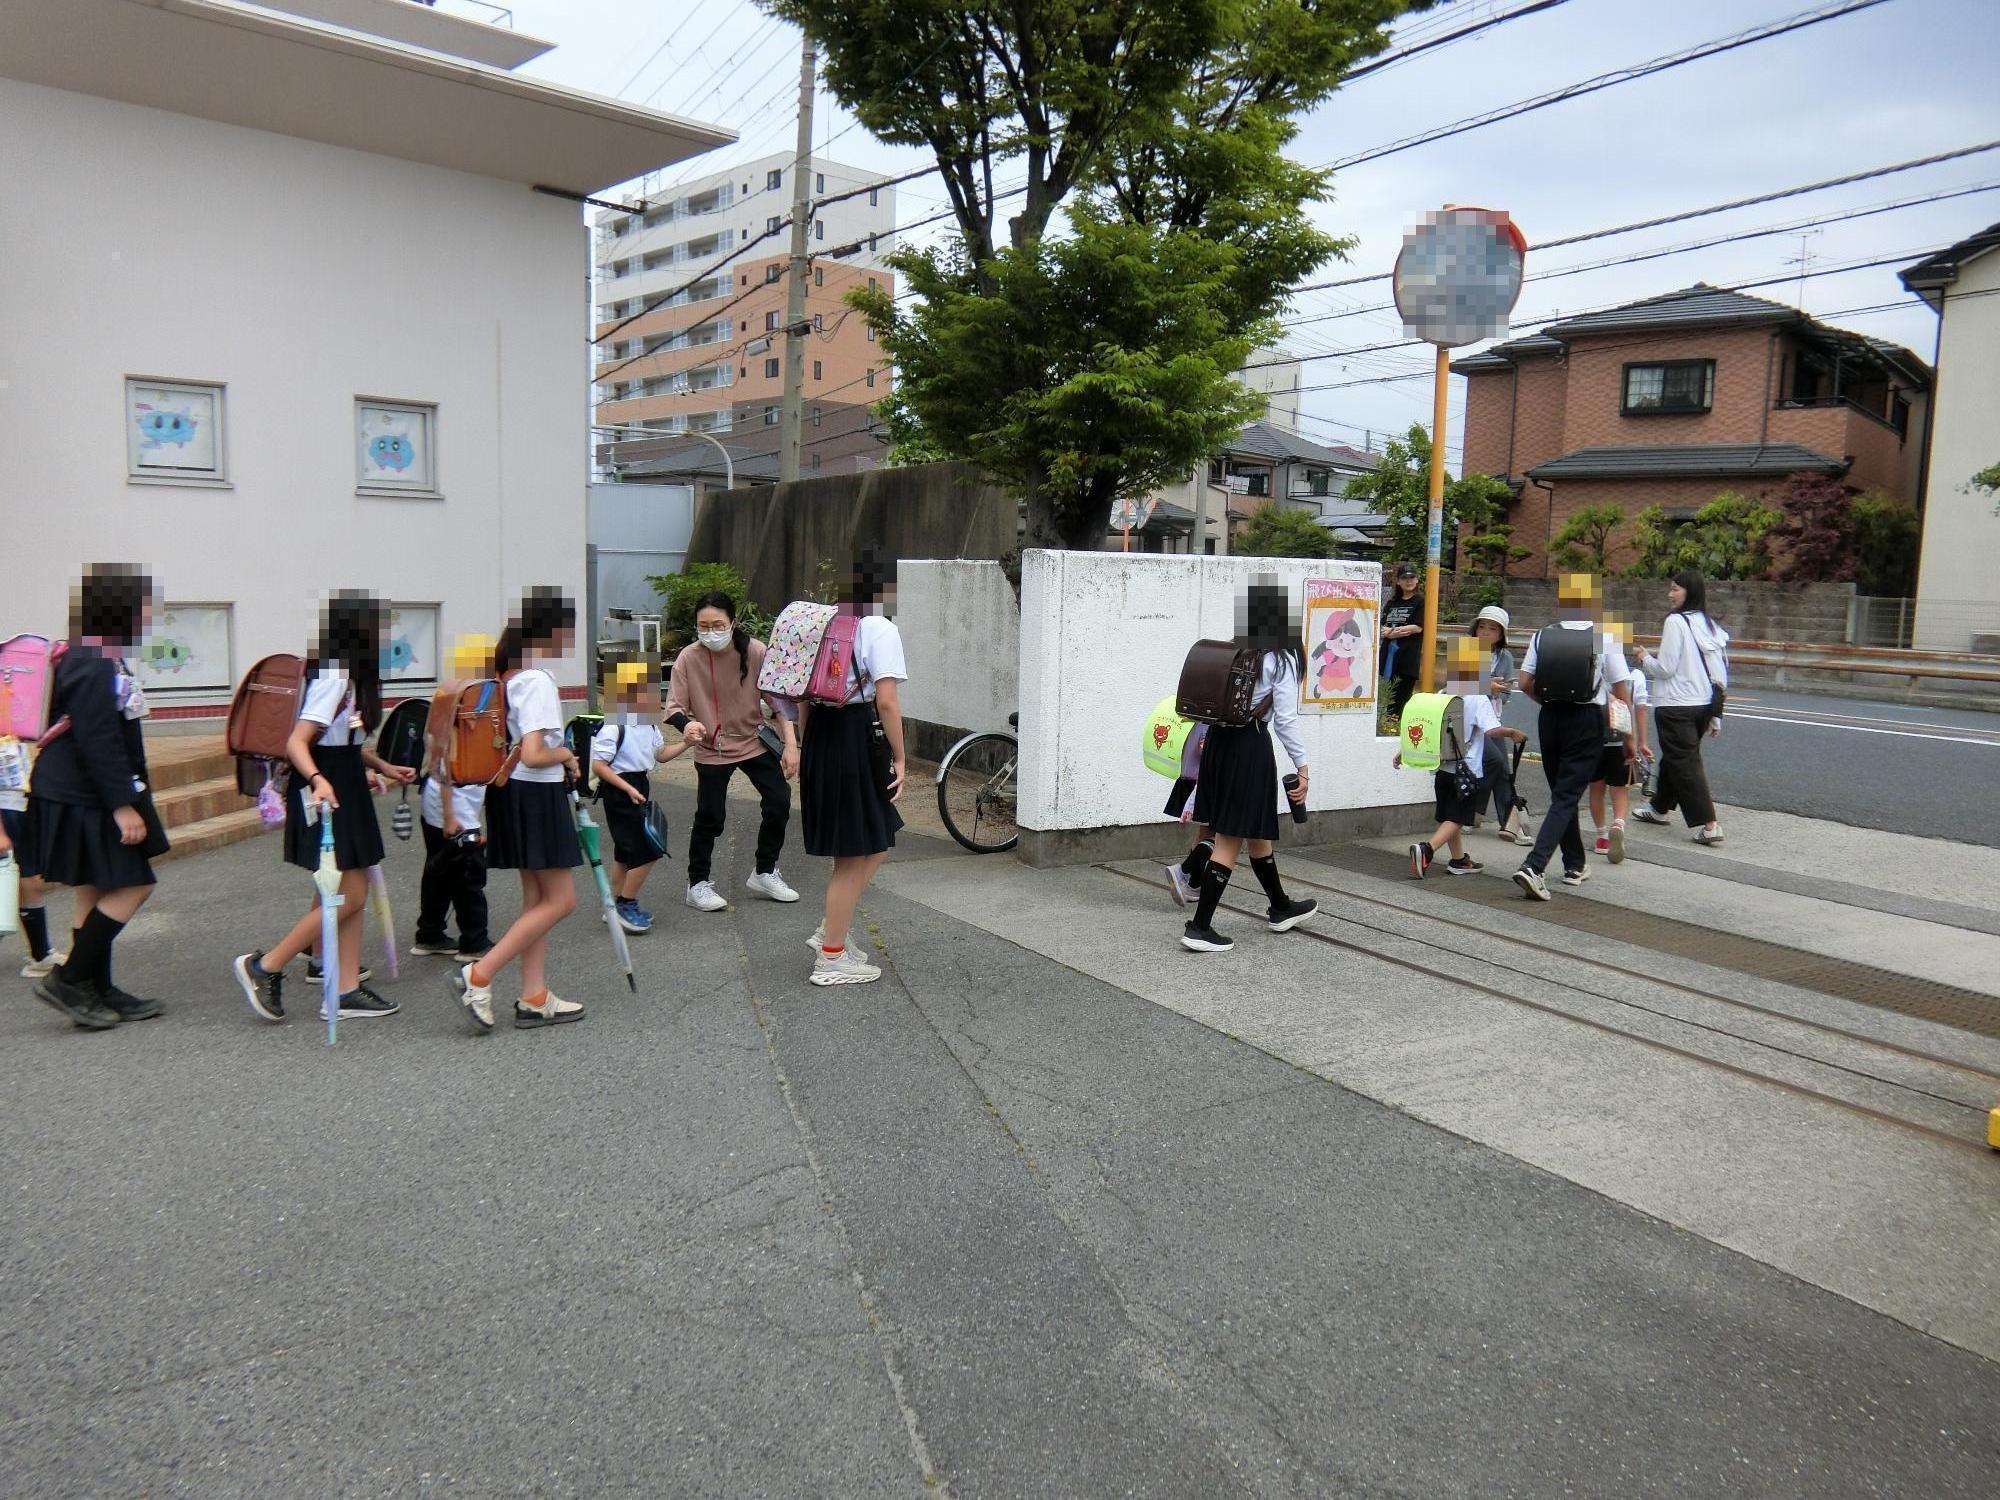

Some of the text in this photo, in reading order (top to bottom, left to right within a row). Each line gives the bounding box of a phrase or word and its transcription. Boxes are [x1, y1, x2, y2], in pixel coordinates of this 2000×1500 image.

[1308, 583, 1375, 599] 飛び出し注意
